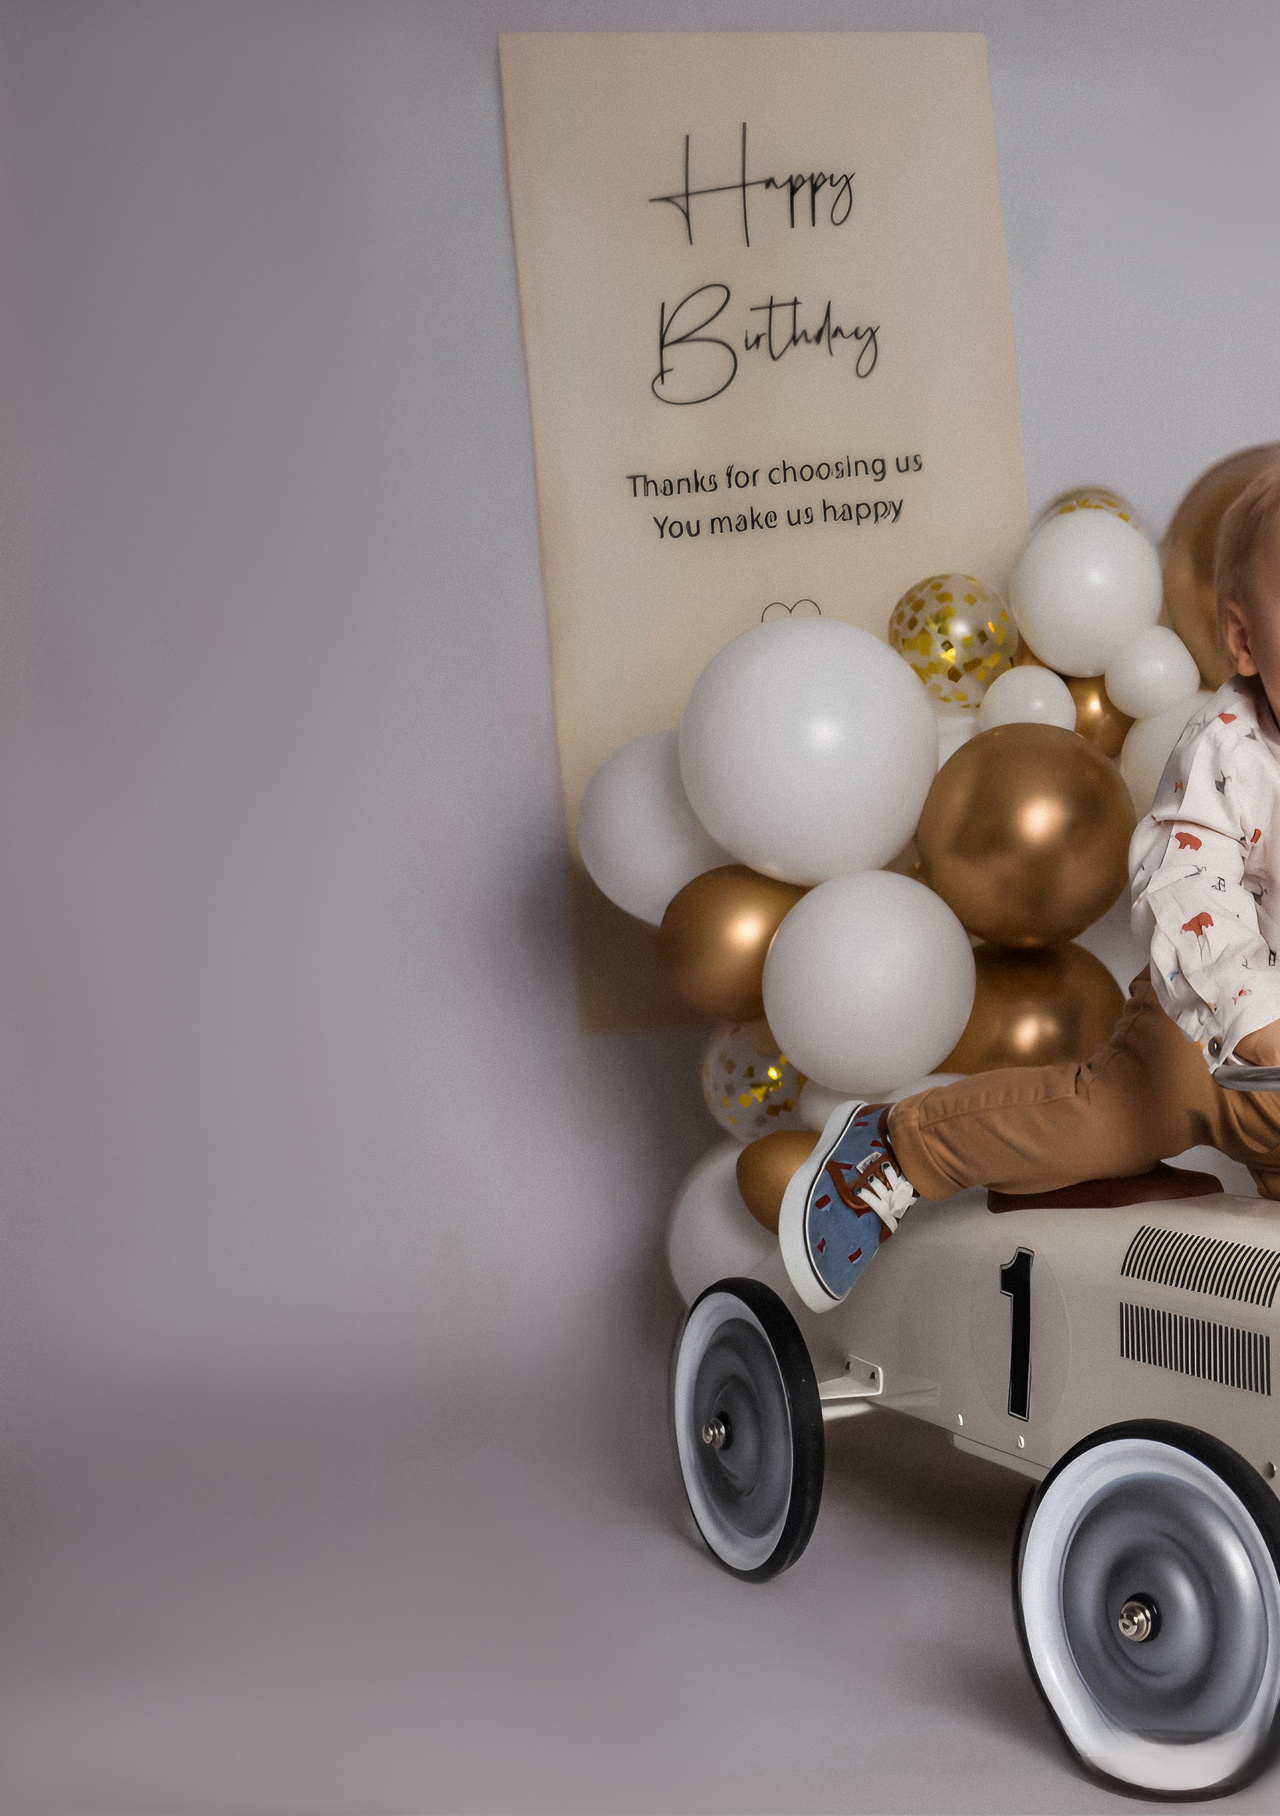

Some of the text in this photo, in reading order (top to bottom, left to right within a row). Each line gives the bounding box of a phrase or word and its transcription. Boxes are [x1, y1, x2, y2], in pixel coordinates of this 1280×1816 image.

[648, 121, 856, 248] Happy
[651, 283, 881, 405] Birthday
[626, 453, 923, 498] Thanks for choosing us
[653, 498, 904, 539] You make us happy
[999, 1246, 1036, 1422] 1
